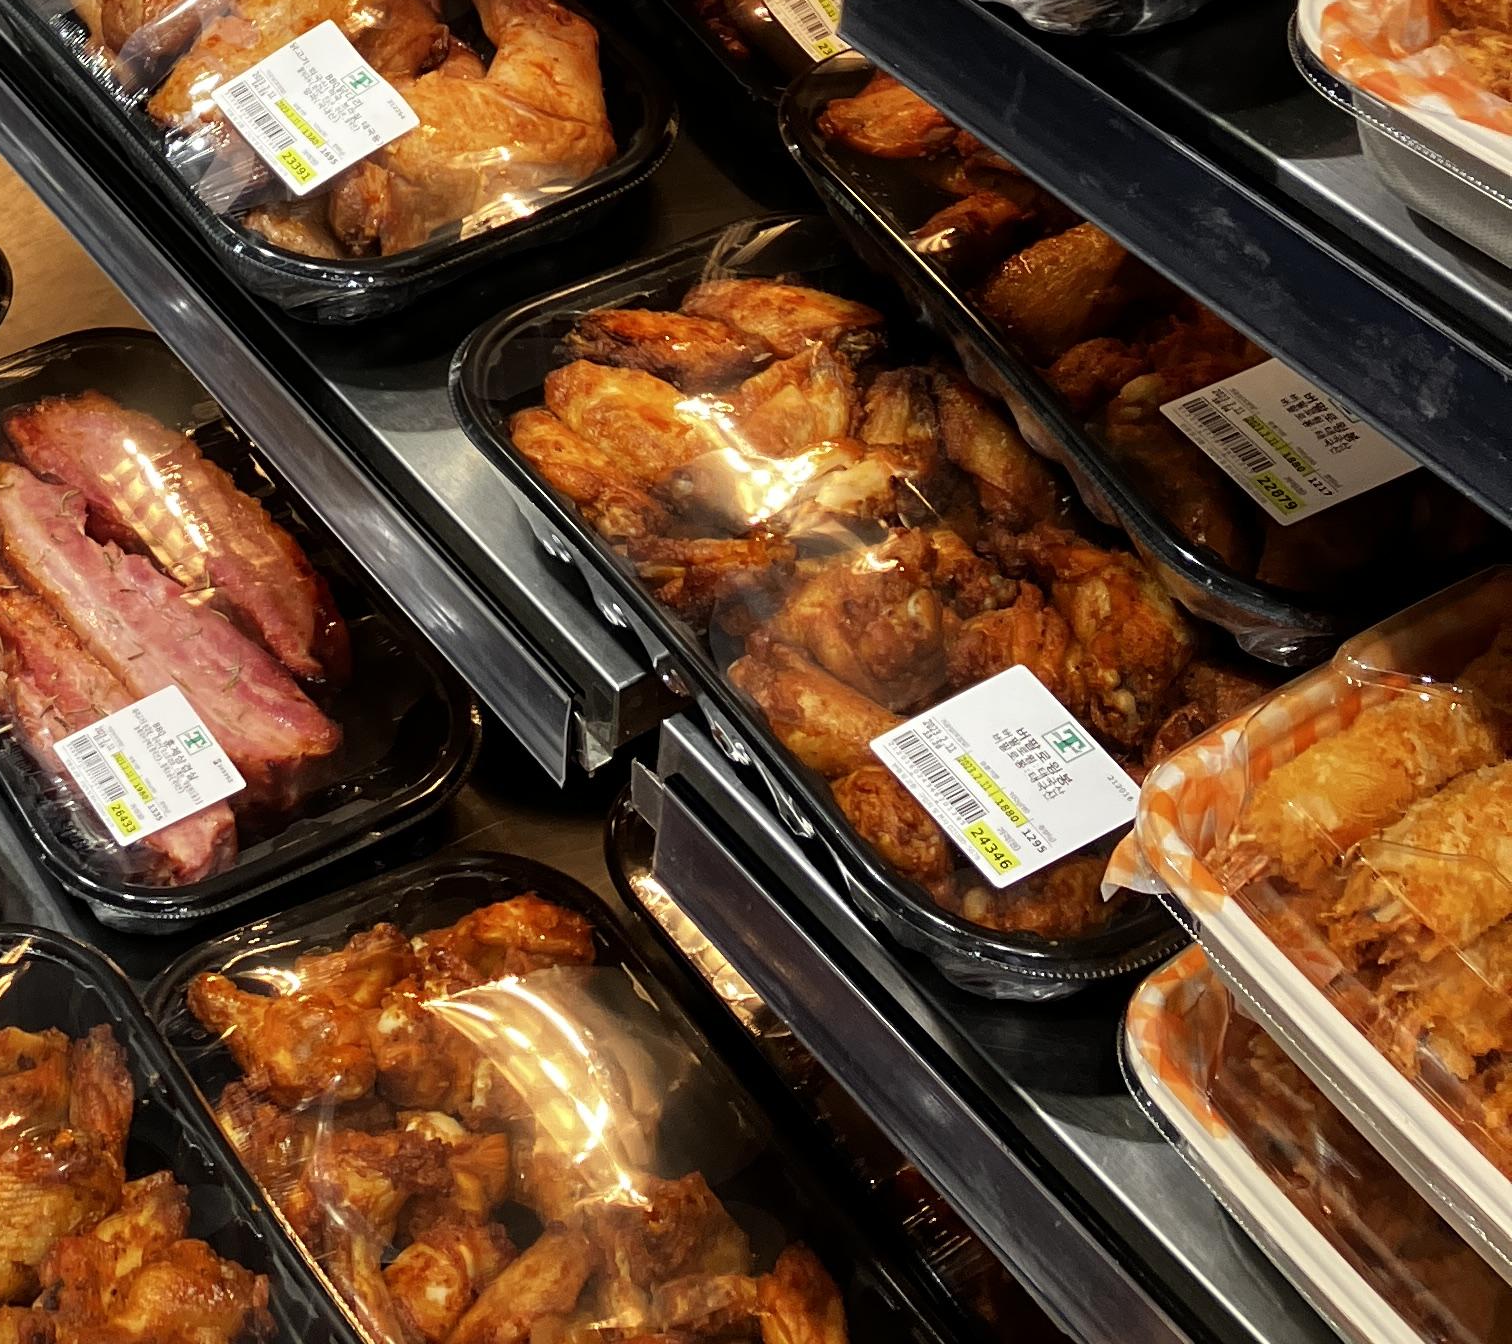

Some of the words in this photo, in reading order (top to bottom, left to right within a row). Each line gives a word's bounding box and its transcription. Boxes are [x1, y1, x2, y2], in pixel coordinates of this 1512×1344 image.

[281, 151, 311, 181] 23391
[1257, 475, 1298, 511] 22879
[111, 803, 136, 833] 26433
[993, 798, 1020, 823] 1880
[1020, 828, 1048, 853] 1295
[969, 826, 1014, 870] 24346
